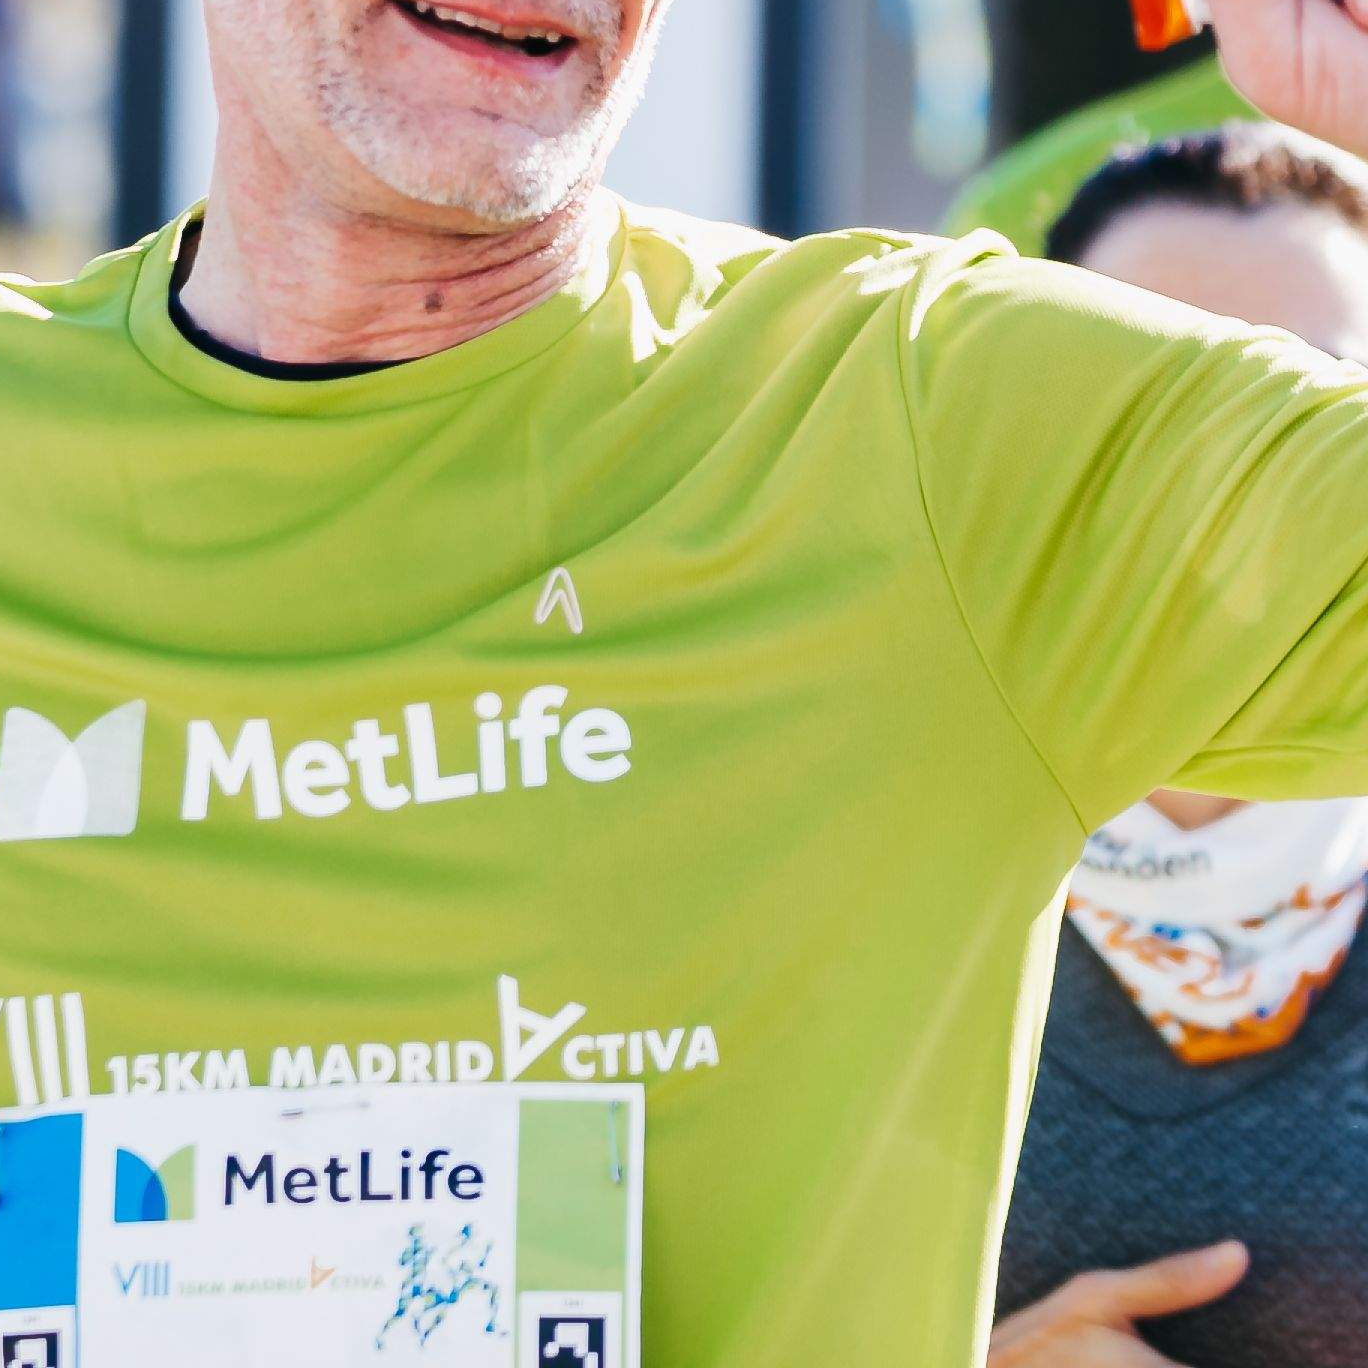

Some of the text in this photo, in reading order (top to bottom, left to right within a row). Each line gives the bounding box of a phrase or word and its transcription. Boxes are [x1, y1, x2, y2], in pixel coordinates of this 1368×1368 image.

[181, 685, 632, 821] MetLife
[105, 1048, 251, 1096] 15KM
[270, 1040, 493, 1087] MADRID
[224, 1149, 484, 1206] MetLife
[112, 1261, 172, 1298] VIII
[232, 1276, 308, 1295] MADRID
